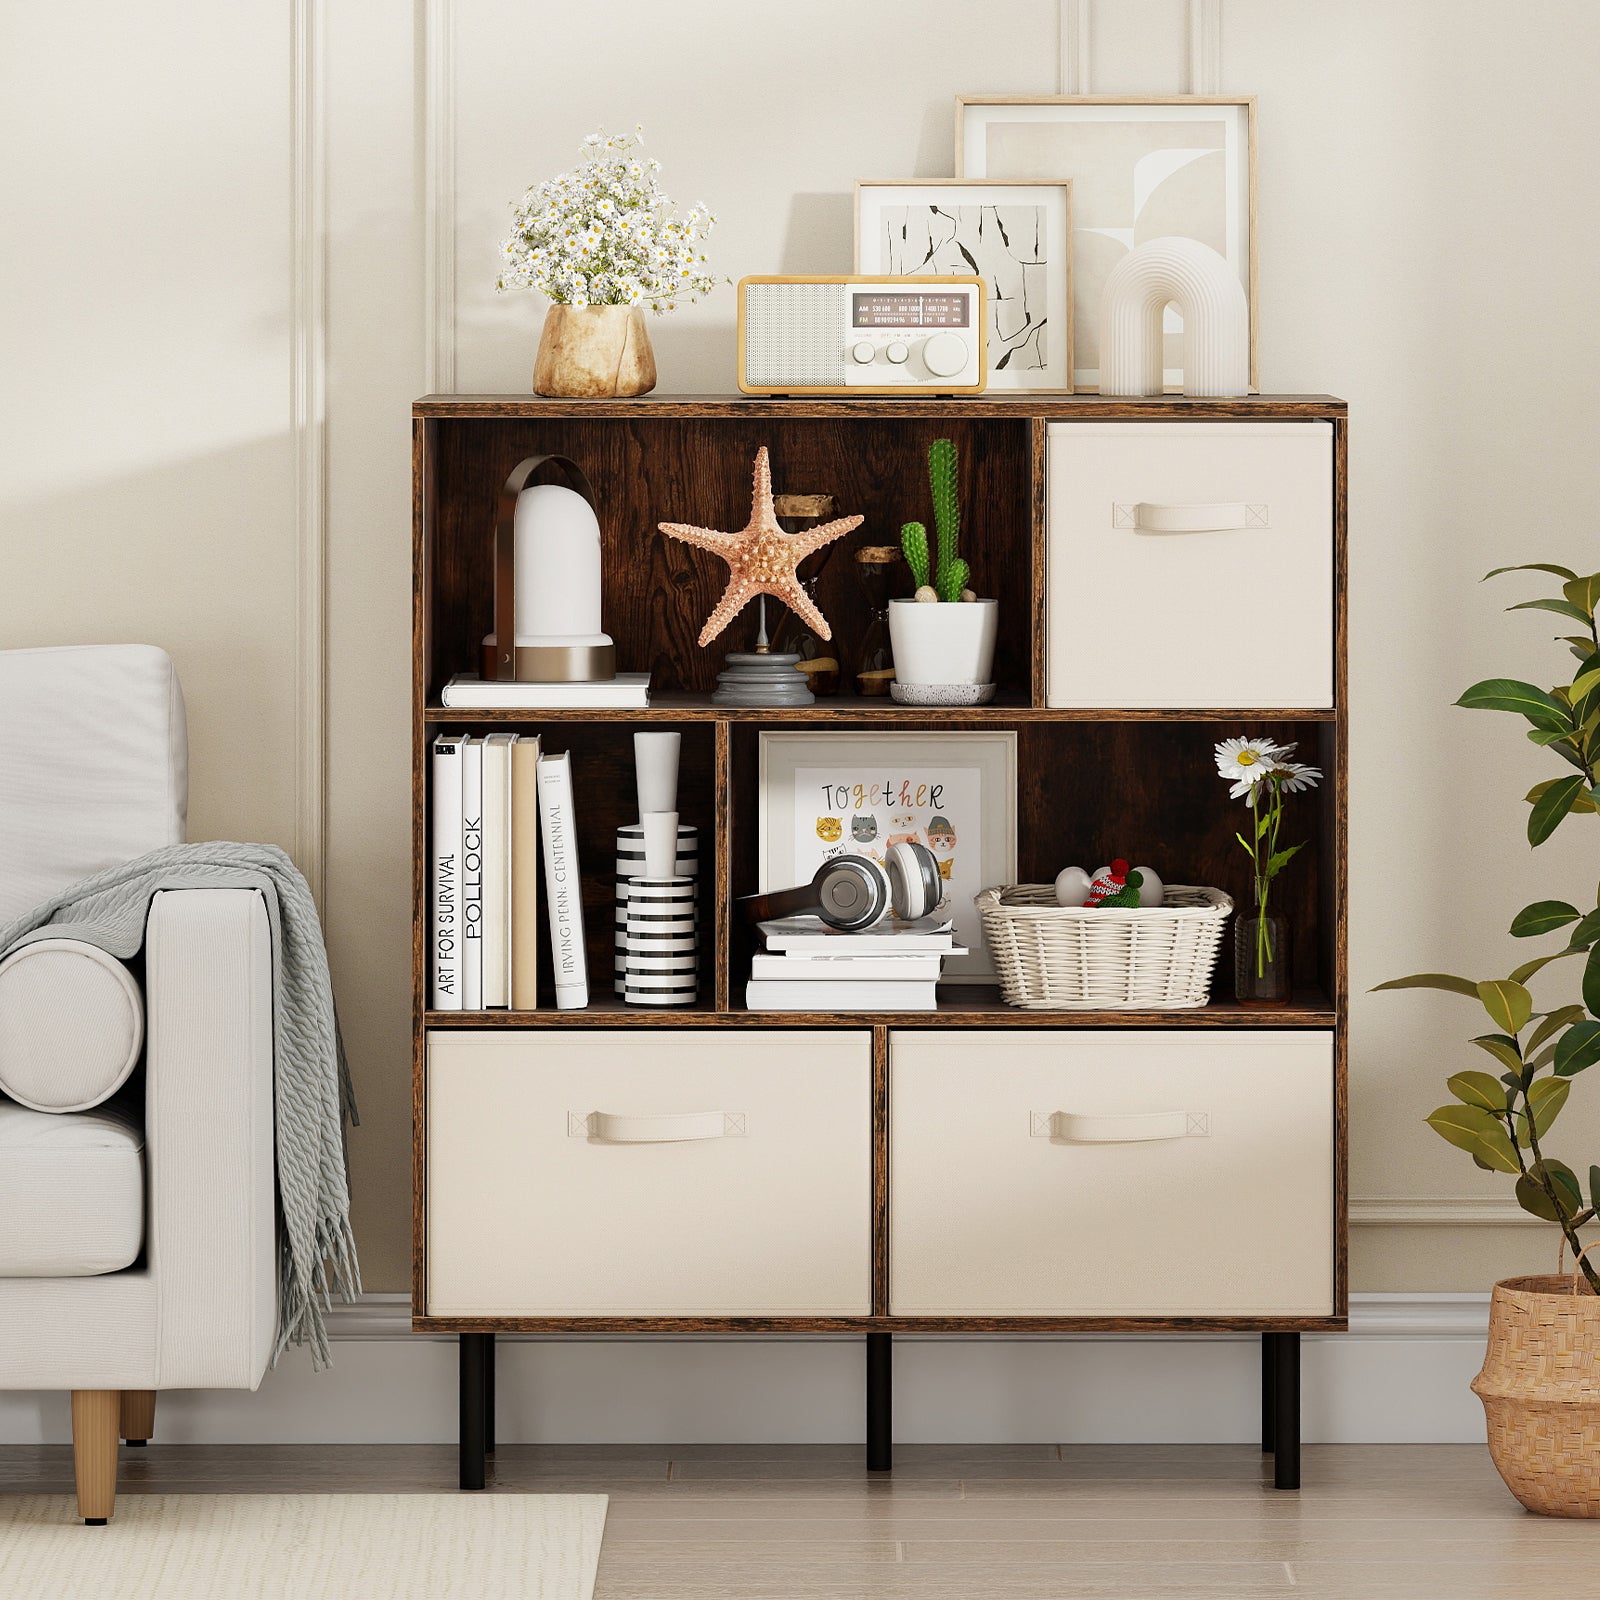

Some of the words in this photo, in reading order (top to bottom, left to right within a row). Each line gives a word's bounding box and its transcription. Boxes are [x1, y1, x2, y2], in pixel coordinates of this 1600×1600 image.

[549, 804, 567, 883] CENTENNIAL
[438, 853, 455, 924] SURVIVAL
[464, 816, 482, 939] POLLOCK
[556, 886, 570, 923] PENN:
[438, 928, 455, 960] FOR
[559, 926, 575, 974] IRVING
[437, 965, 455, 995] ART
